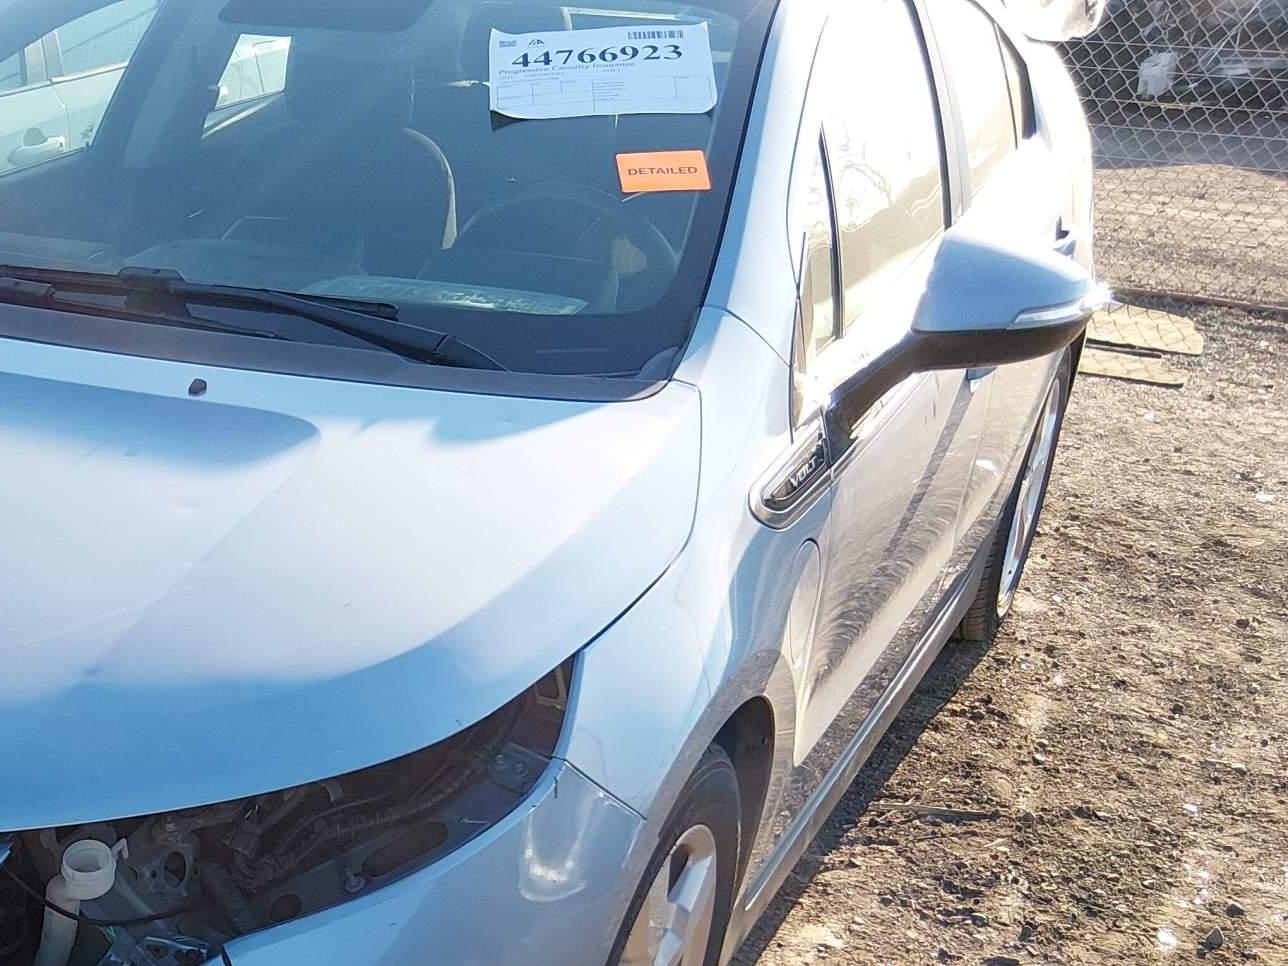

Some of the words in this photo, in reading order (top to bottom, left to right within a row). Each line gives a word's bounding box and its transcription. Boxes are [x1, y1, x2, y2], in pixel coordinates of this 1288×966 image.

[511, 44, 683, 68] 44766923
[498, 67, 549, 75] Progressive
[627, 165, 698, 177] DETAILED
[789, 455, 818, 488] VOLT
